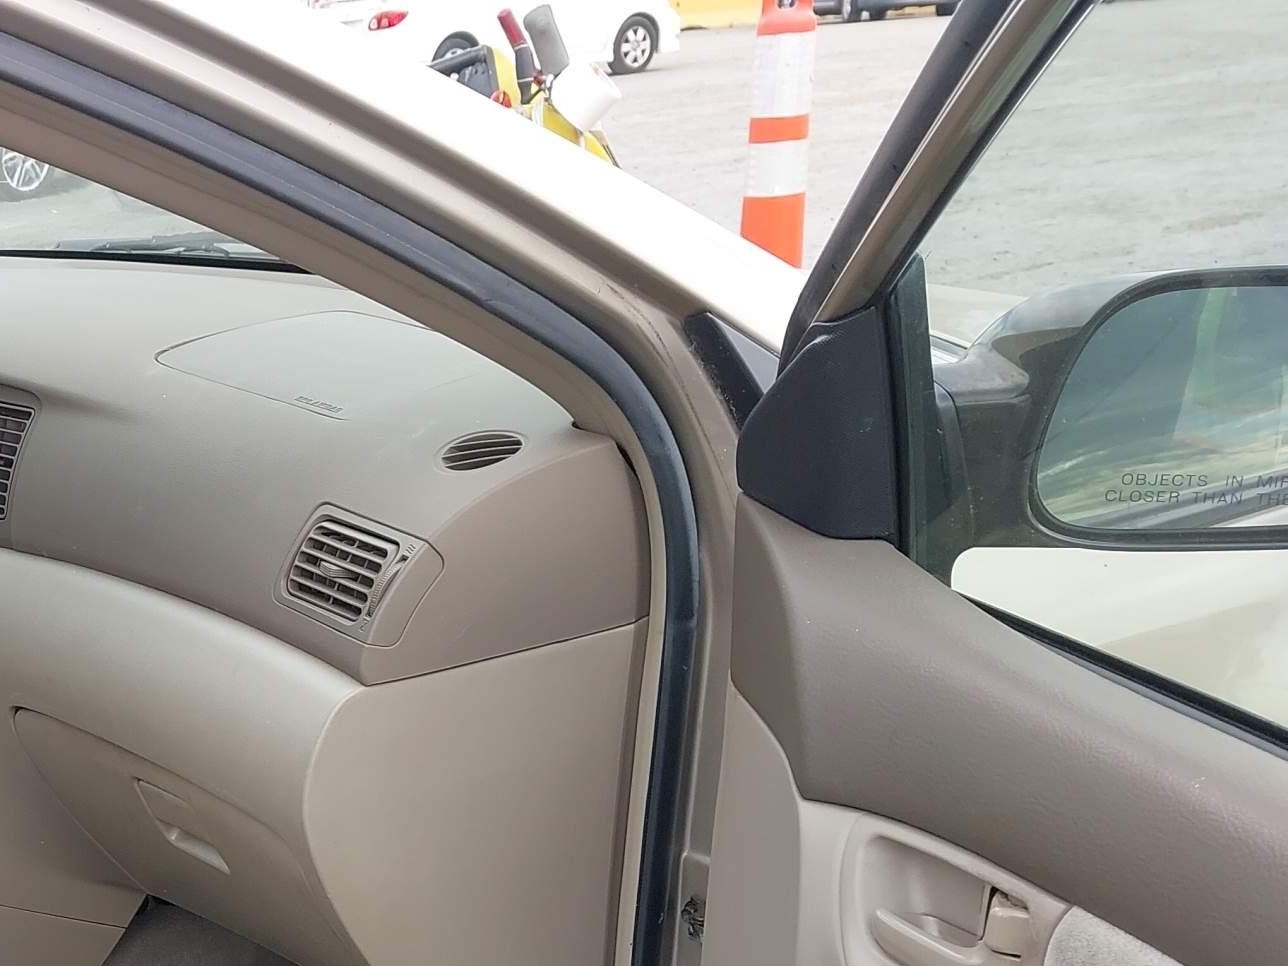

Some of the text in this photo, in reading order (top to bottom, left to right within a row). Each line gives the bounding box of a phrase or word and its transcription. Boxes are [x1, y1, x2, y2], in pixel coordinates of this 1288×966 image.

[1121, 472, 1208, 487] OBJECTS
[1225, 475, 1244, 488] IN
[1104, 489, 1180, 503] CLOSER
[1192, 491, 1243, 504] THAN
